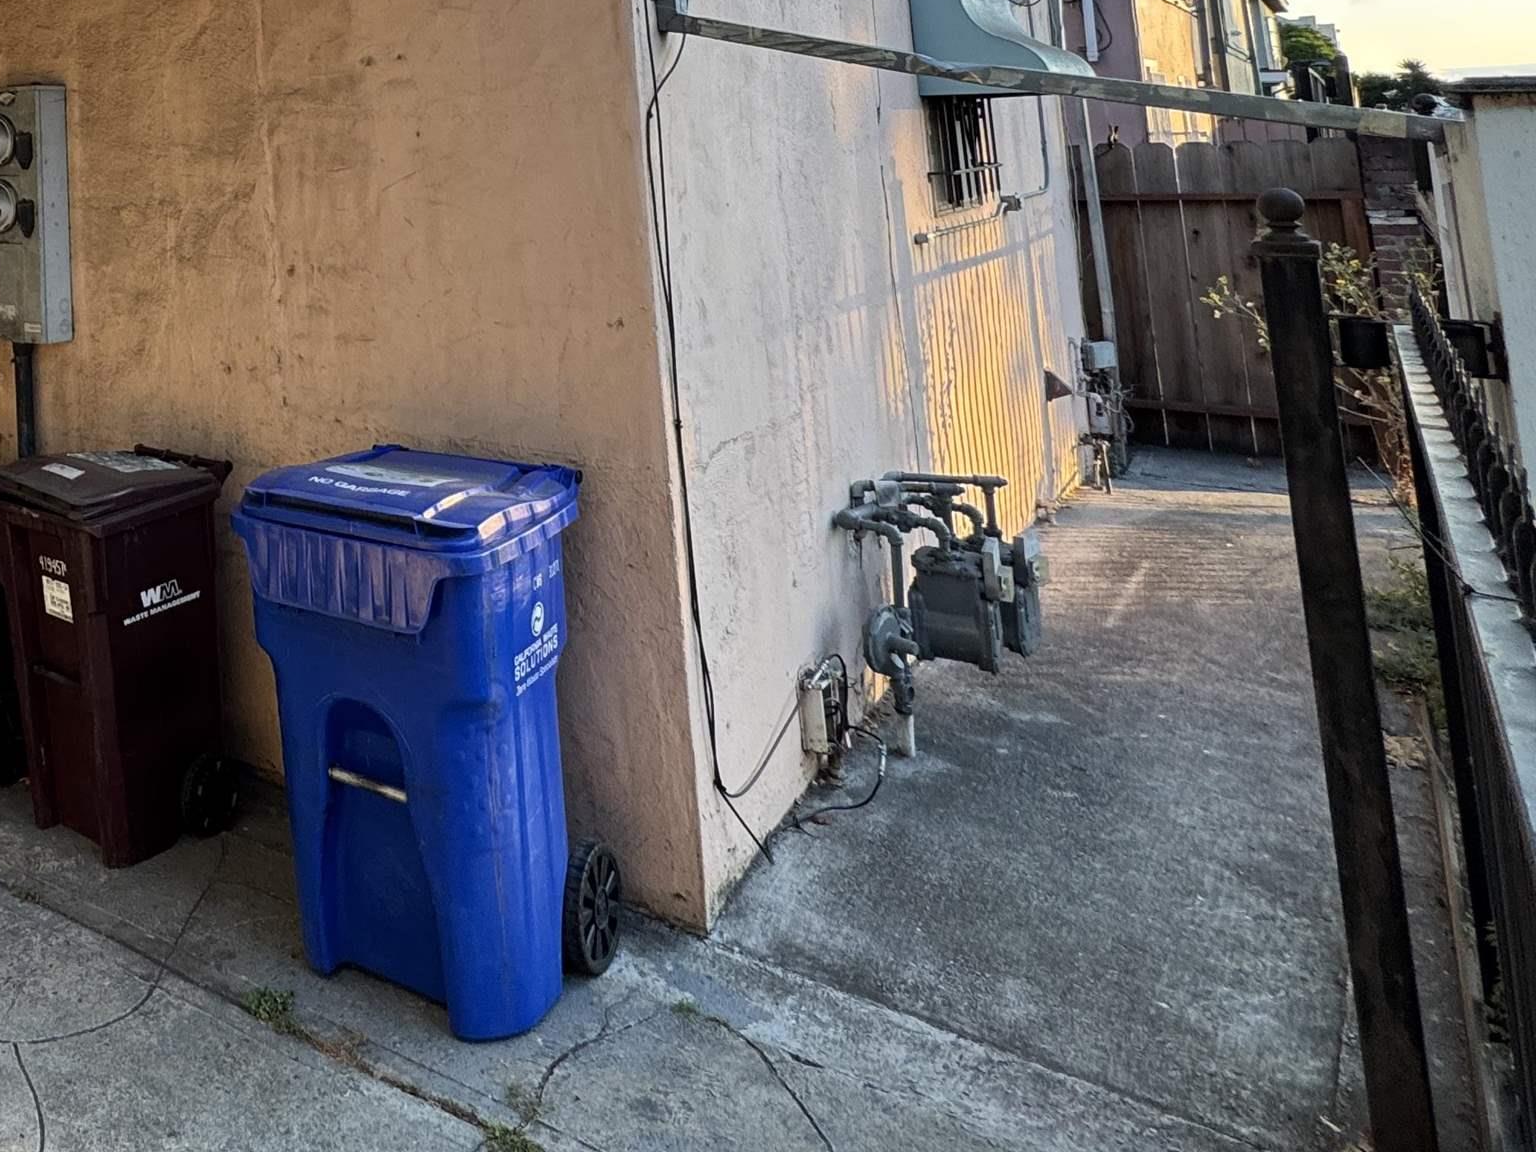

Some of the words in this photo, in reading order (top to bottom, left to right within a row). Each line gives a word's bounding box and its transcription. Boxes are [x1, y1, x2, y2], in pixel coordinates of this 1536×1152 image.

[308, 476, 334, 485] NO
[334, 480, 411, 497] GARBAGE
[123, 610, 149, 626] WASTE
[149, 590, 201, 616] MANAGEMENT
[140, 579, 179, 608] WM
[514, 634, 558, 682] SOLUTIONS
